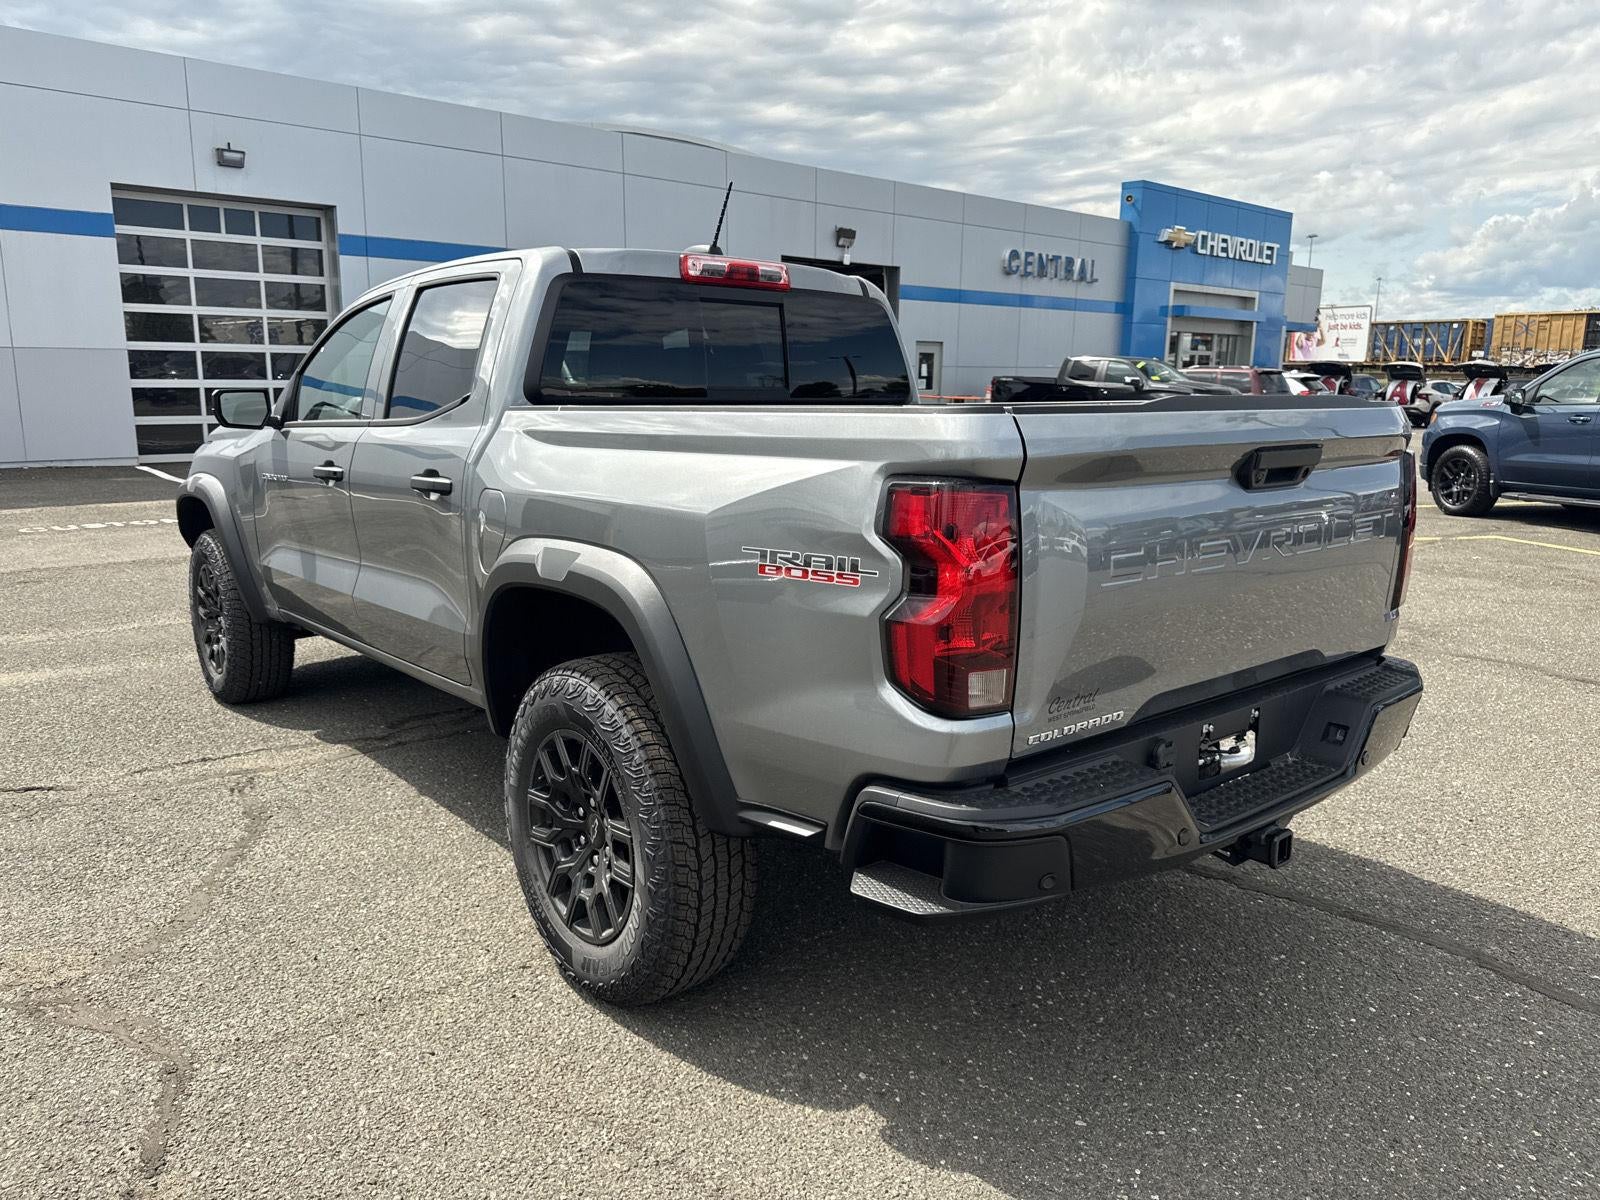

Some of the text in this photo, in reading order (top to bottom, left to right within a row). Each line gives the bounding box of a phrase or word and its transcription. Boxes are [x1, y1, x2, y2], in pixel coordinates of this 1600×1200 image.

[1195, 230, 1280, 265] CHEVROLET
[1001, 248, 1099, 283] CENTRAL
[1327, 323, 1339, 332] just
[1356, 311, 1368, 319] kids
[742, 546, 879, 577] TRAIL
[1101, 508, 1395, 587] CHEVROLET
[758, 563, 860, 587] BOSS
[1048, 688, 1101, 714] Central
[1027, 710, 1125, 745] COLORADO
